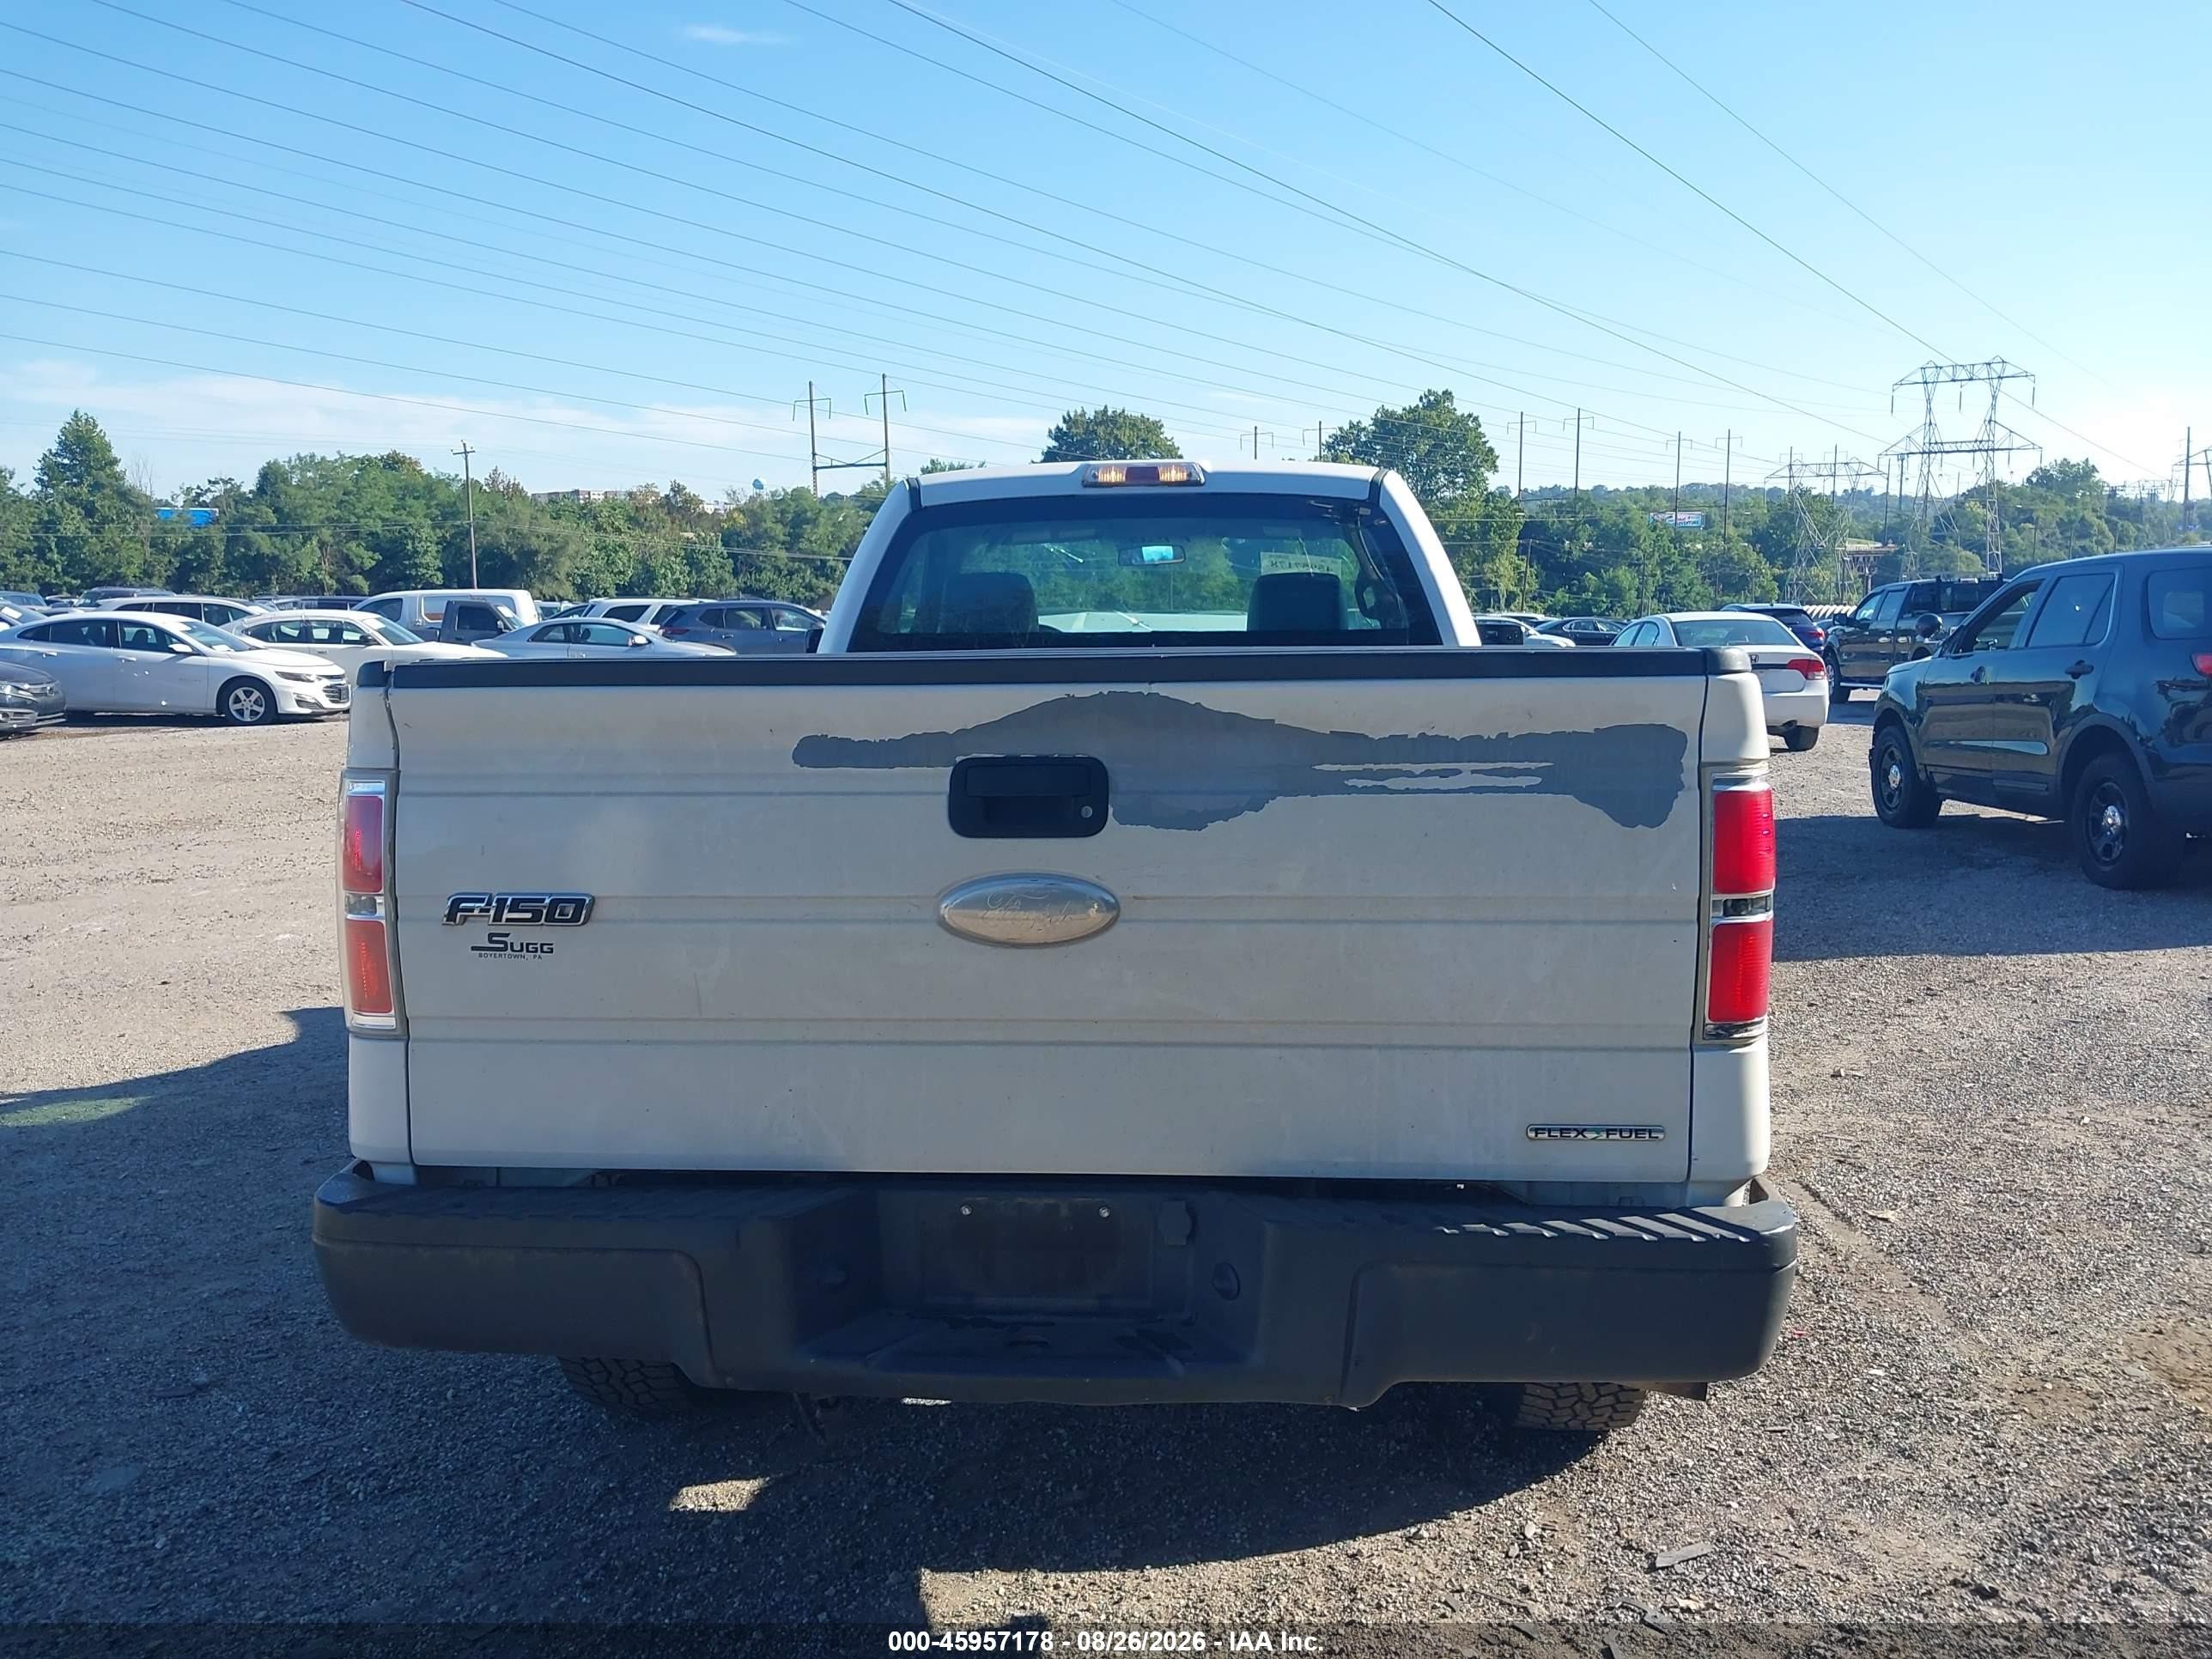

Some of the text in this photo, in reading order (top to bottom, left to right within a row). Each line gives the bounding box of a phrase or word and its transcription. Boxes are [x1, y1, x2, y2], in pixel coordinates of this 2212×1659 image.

[442, 892, 595, 926] F-150
[478, 952, 528, 961] BOYERTOWN,
[1534, 1127, 1660, 1139] FLEX FUEL
